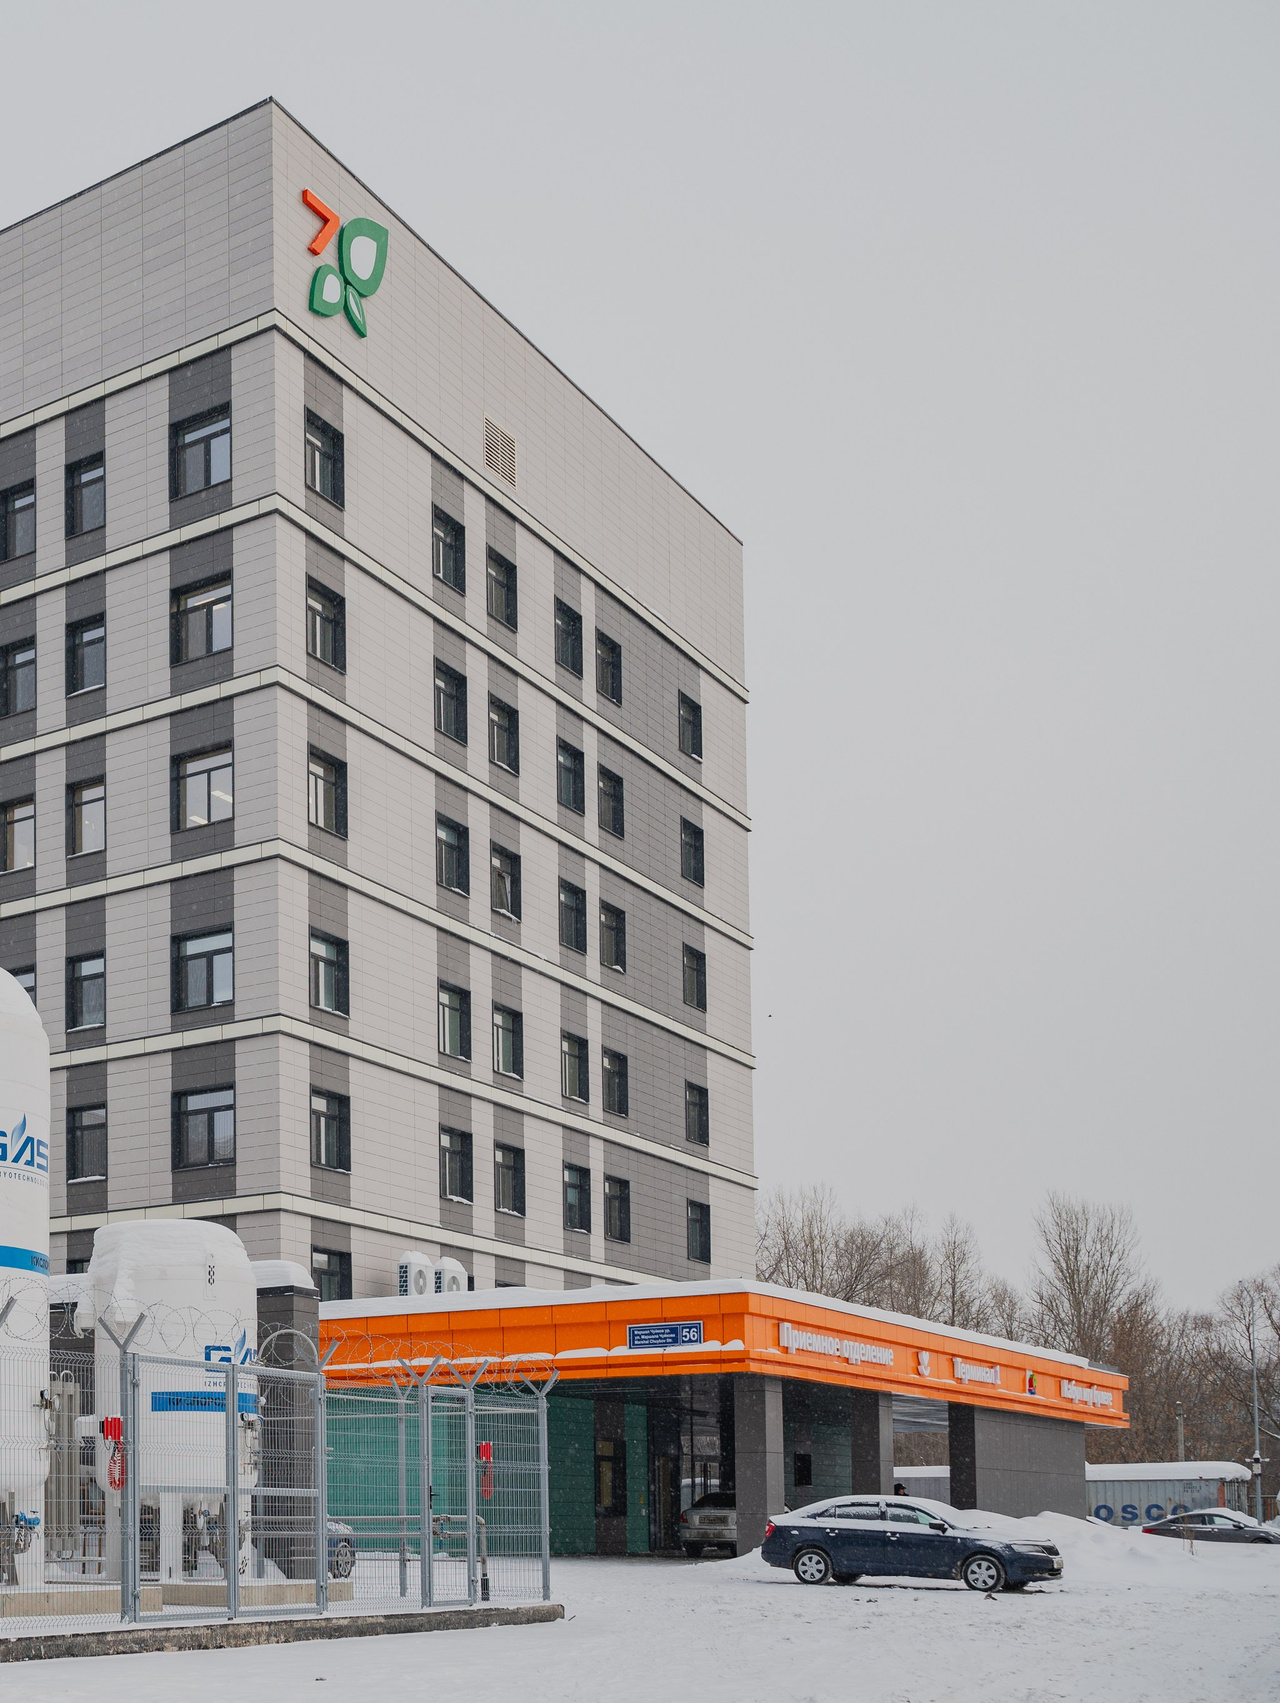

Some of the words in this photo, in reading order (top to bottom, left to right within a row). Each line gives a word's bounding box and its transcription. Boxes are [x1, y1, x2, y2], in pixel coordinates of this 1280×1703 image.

[31, 1255, 49, 1271] КИСЛО
[682, 1328, 698, 1341] 56
[779, 1322, 840, 1356] Приемное
[842, 1340, 894, 1366] отделение
